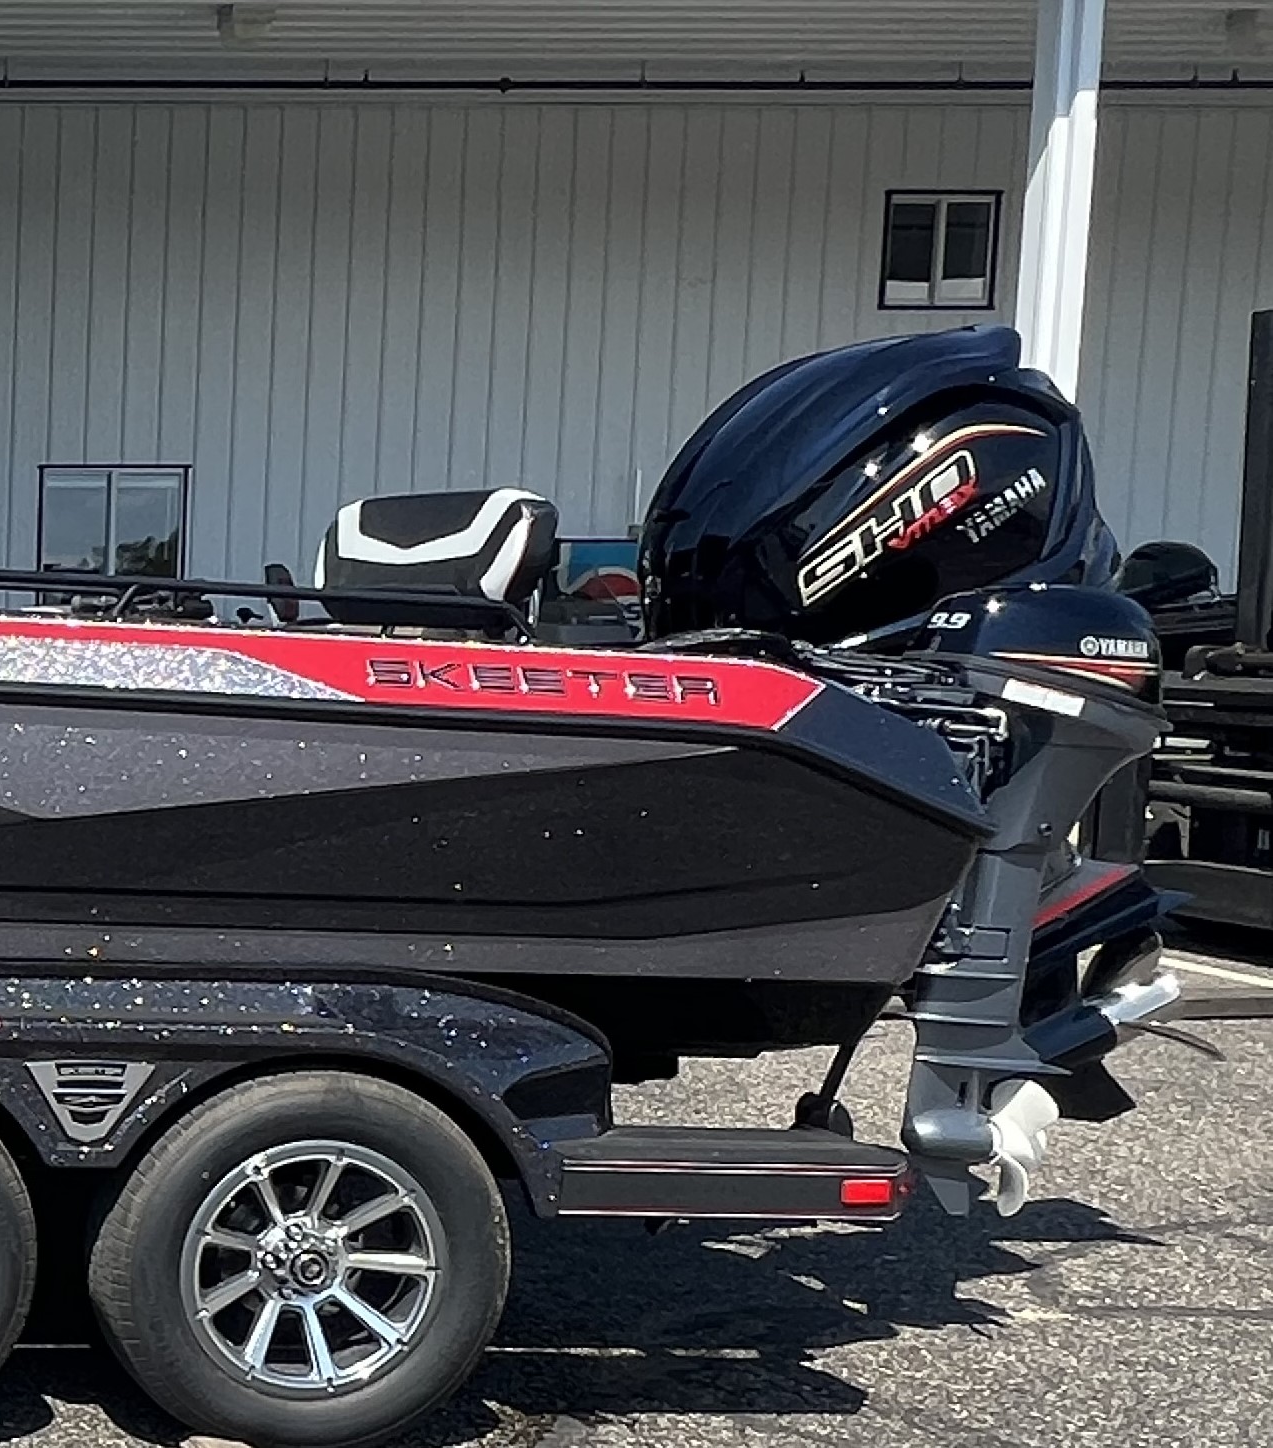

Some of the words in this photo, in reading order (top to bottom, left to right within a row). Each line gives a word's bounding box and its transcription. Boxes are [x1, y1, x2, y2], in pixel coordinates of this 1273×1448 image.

[797, 449, 978, 607] SHO
[955, 467, 1047, 543] YAMAHA
[366, 659, 722, 706] SKEETER
